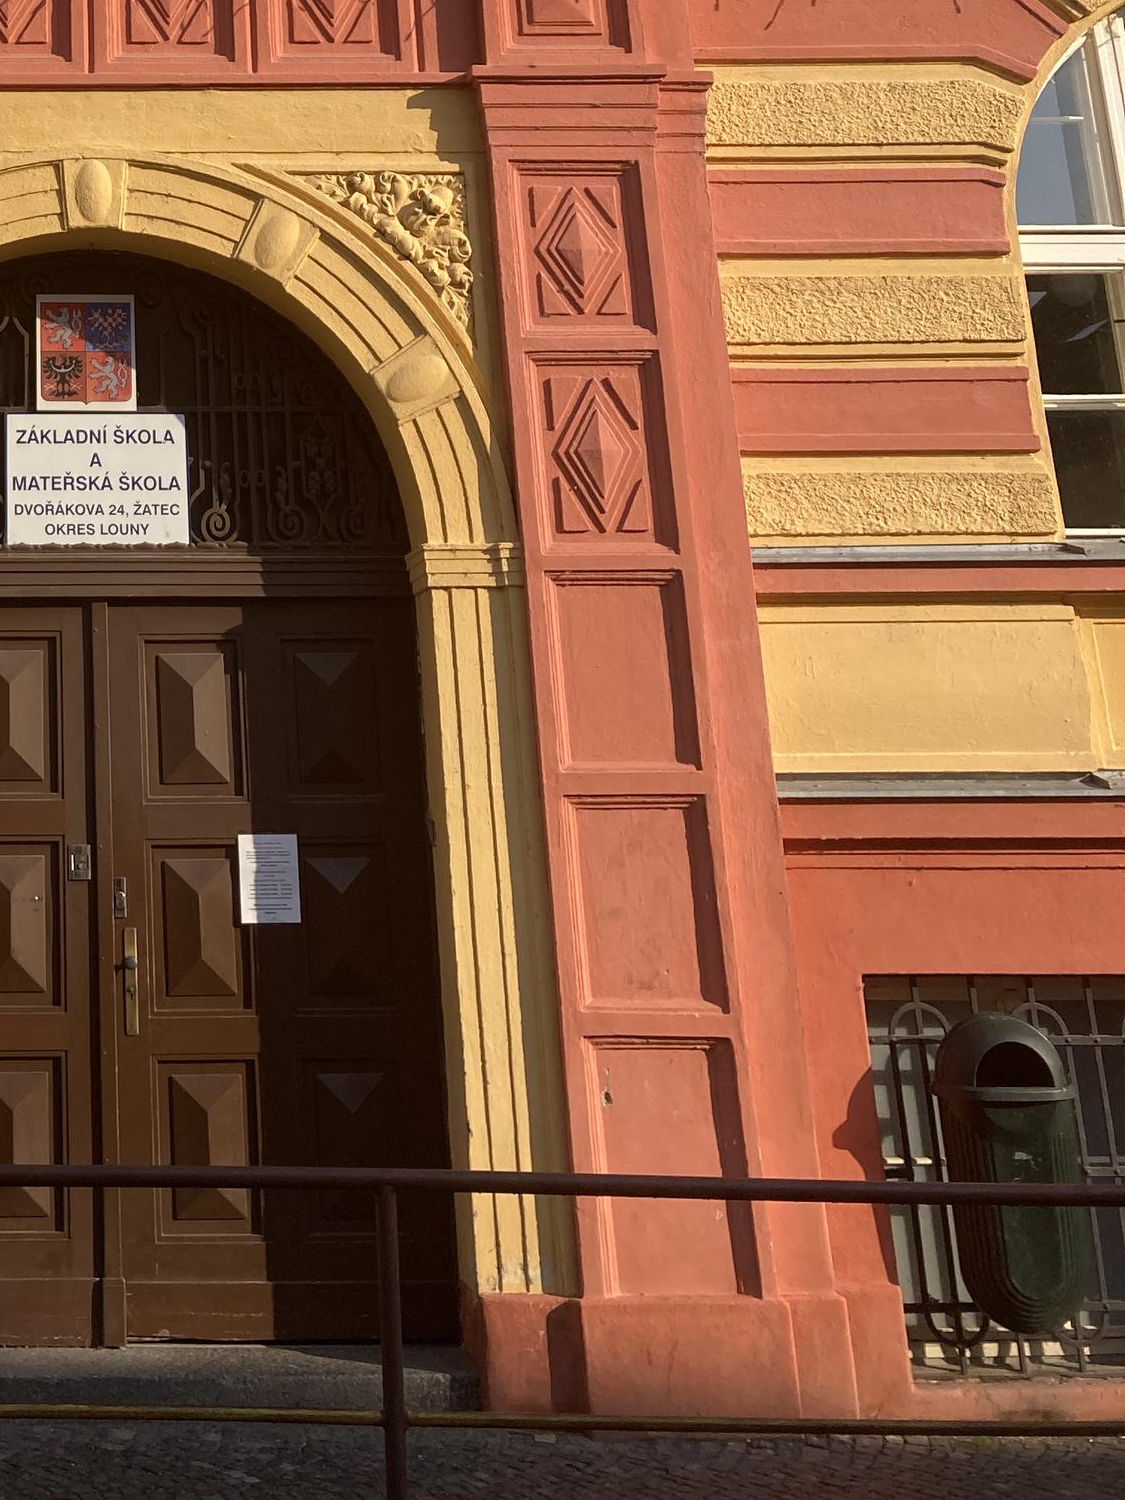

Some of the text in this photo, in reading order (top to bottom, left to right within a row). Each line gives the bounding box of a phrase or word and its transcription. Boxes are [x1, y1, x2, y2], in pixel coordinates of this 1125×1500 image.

[15, 425, 175, 445] ZÁKLADNÍ ŠKOLA
[89, 452, 102, 467] A
[12, 471, 181, 491] MATEŘSKÁ ŠKOLA
[14, 500, 180, 518] DVOŘÁKOVA 24, ŽATEC
[44, 523, 150, 536] OKRES LOUNY
